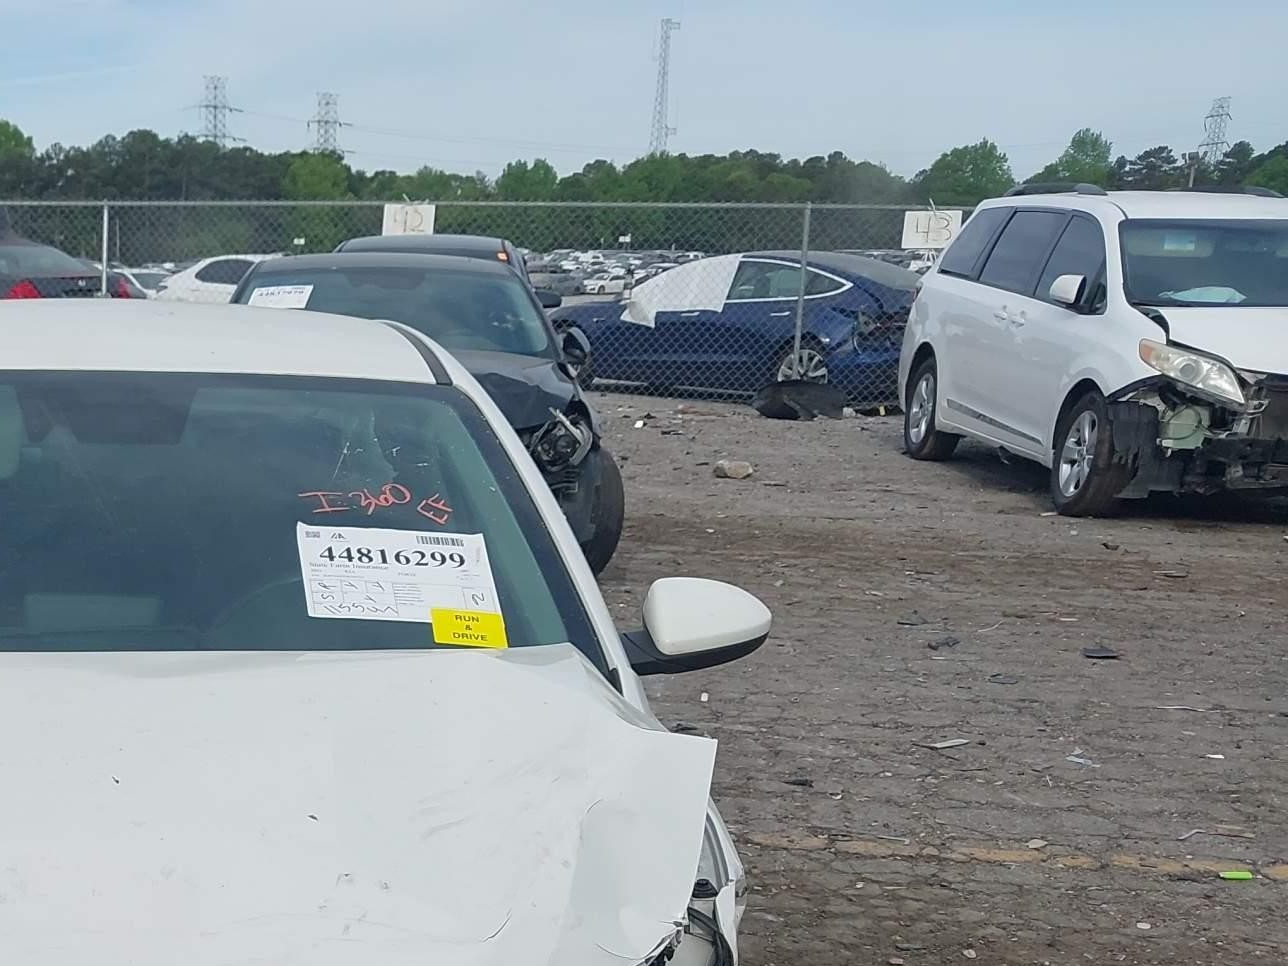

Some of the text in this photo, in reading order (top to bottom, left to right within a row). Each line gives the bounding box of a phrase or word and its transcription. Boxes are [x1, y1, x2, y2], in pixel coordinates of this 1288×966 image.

[915, 212, 953, 243] 43
[319, 544, 466, 569] 44816299
[454, 614, 480, 623] RUN
[452, 632, 489, 642] DRIVE
